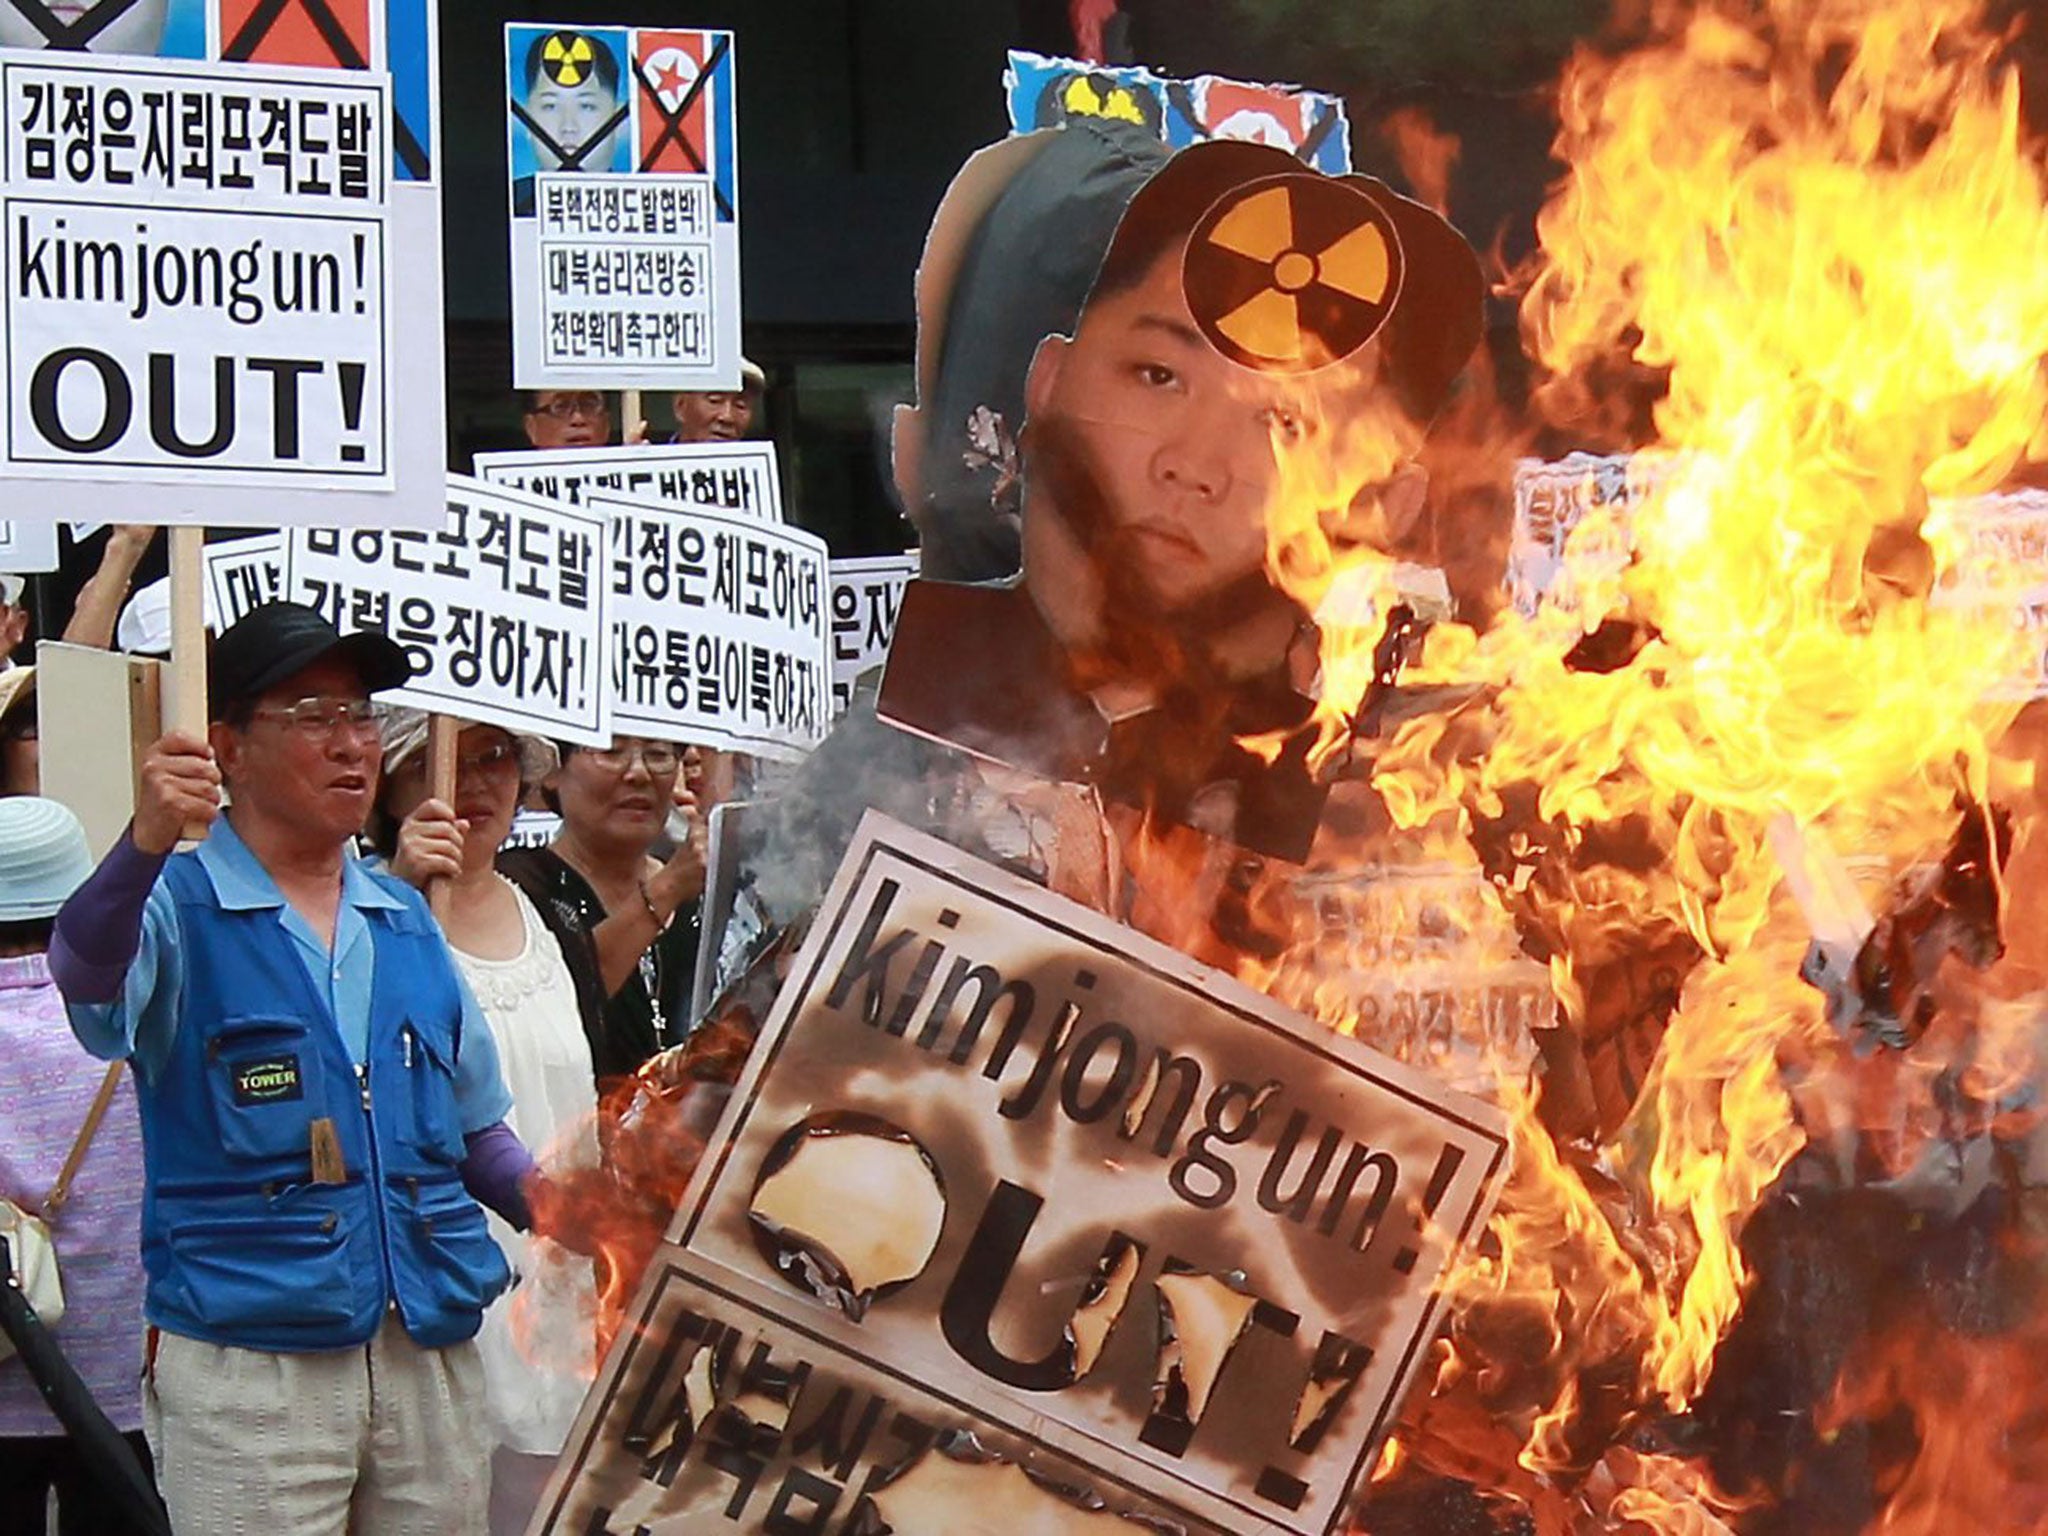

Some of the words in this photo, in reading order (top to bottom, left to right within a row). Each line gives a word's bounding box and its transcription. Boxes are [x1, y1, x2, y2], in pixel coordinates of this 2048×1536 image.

[20, 82, 372, 199] 김정은지뢰포격도발
[550, 249, 705, 297] 대북심리전방송!
[551, 311, 706, 358] 전면확대촉구한다!
[29, 346, 367, 463] OUT!
[239, 1070, 296, 1090] TOWER
